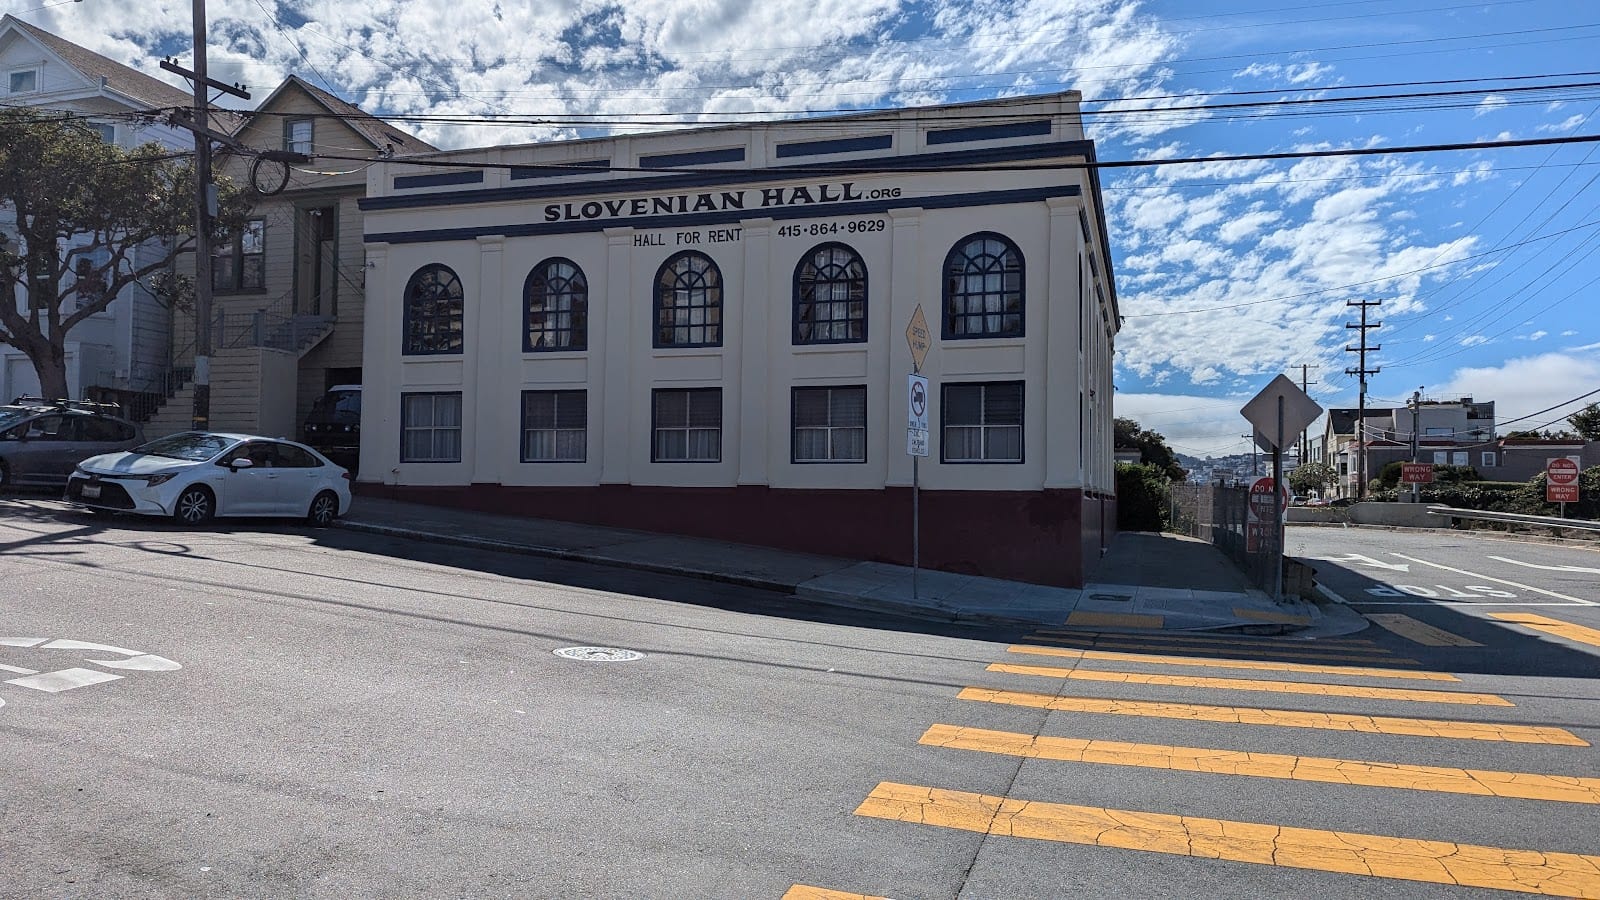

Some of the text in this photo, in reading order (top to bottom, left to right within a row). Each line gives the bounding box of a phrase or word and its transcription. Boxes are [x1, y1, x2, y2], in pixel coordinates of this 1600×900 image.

[544, 191, 747, 222] SLOVENIAN
[633, 228, 742, 247] HALL FOR RENT
[912, 326, 926, 339] SPEED
[912, 339, 927, 351] HUMP
[1408, 473, 1425, 481] WAY
[1254, 484, 1265, 493] DO
[1364, 584, 1517, 598] STOP
